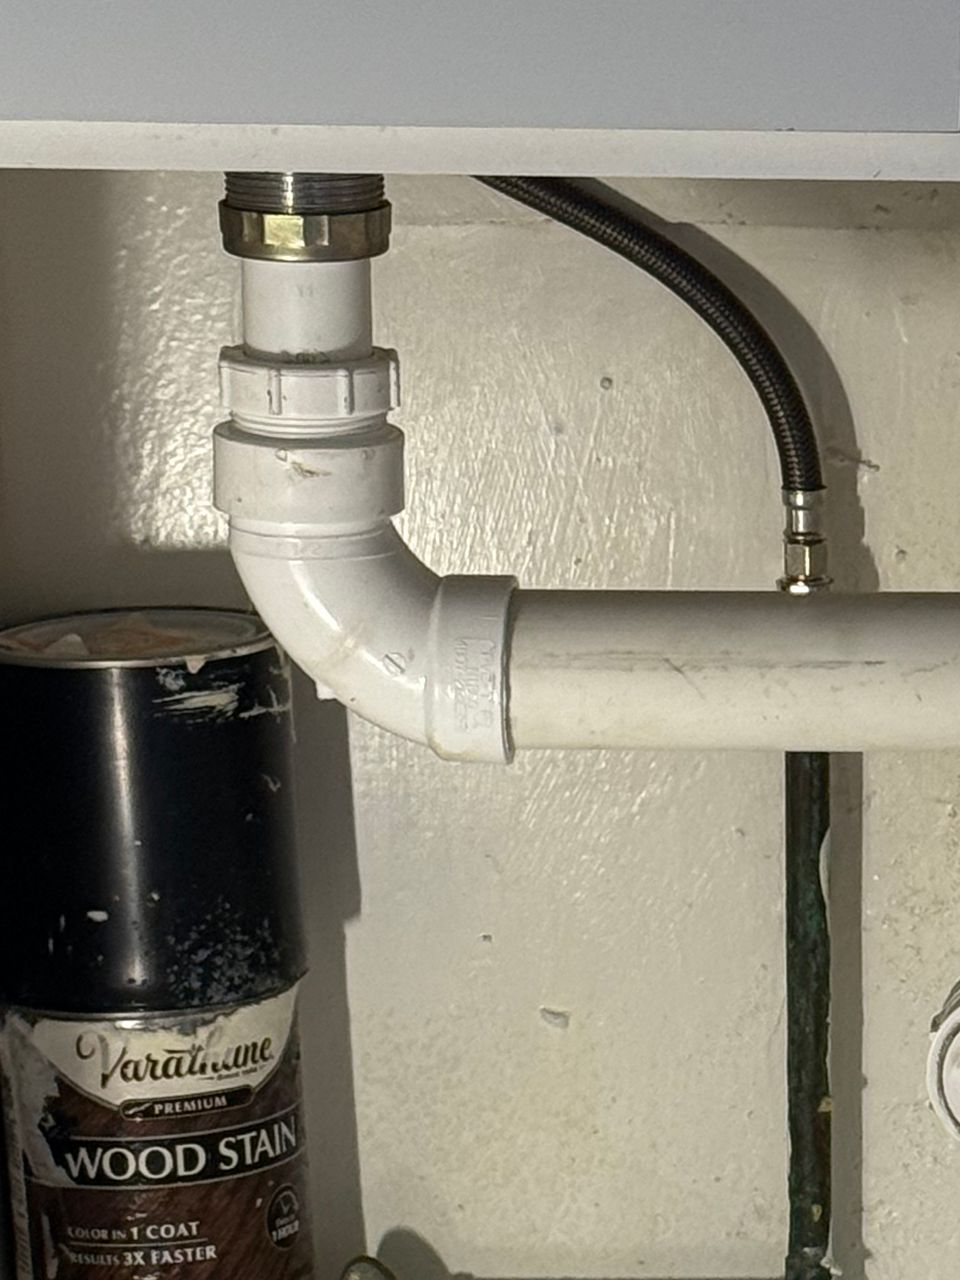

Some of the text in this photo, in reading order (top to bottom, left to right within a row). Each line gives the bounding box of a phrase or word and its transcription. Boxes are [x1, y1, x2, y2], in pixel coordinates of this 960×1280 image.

[153, 1096, 228, 1116] PREMIUM
[64, 1115, 298, 1182] WOOD STAIN
[112, 1228, 127, 1240] IN
[129, 1226, 139, 1241] 1
[145, 1220, 200, 1240] COAT
[122, 1250, 147, 1267] 3X
[150, 1245, 218, 1266] FASTER
